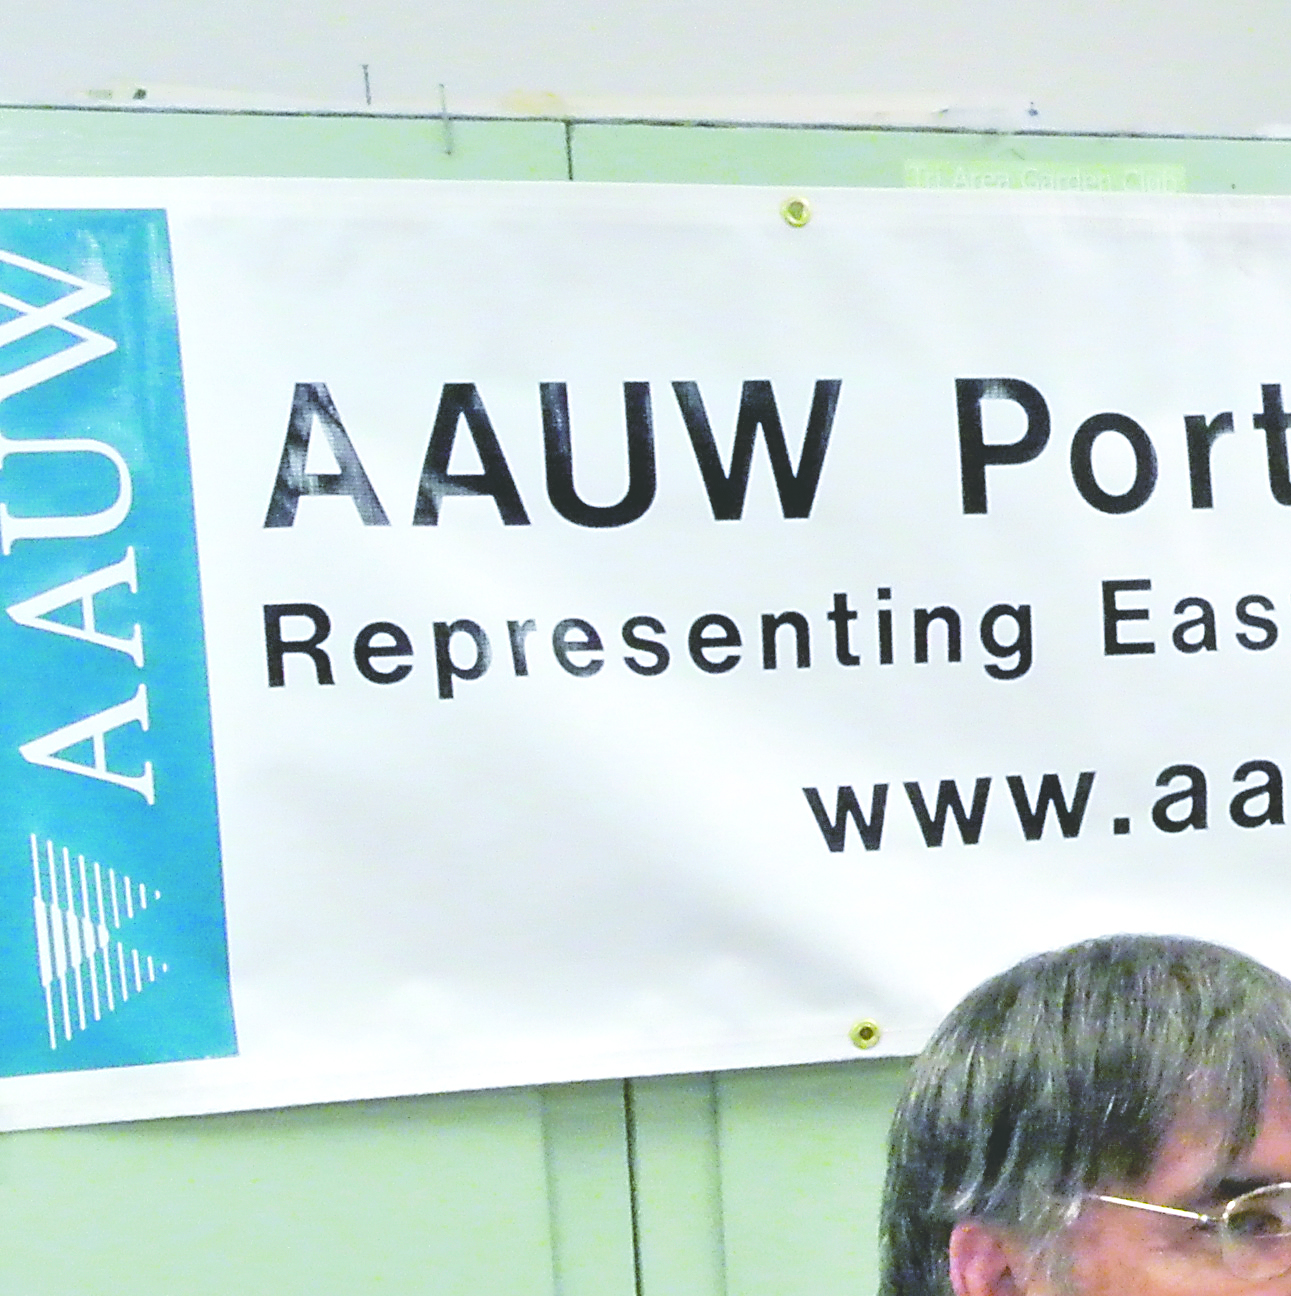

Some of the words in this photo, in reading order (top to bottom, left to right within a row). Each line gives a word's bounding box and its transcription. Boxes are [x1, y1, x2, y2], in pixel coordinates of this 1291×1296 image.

[0, 248, 155, 806] AAUW
[263, 379, 842, 528] AAUW
[262, 587, 1033, 699] Representing
